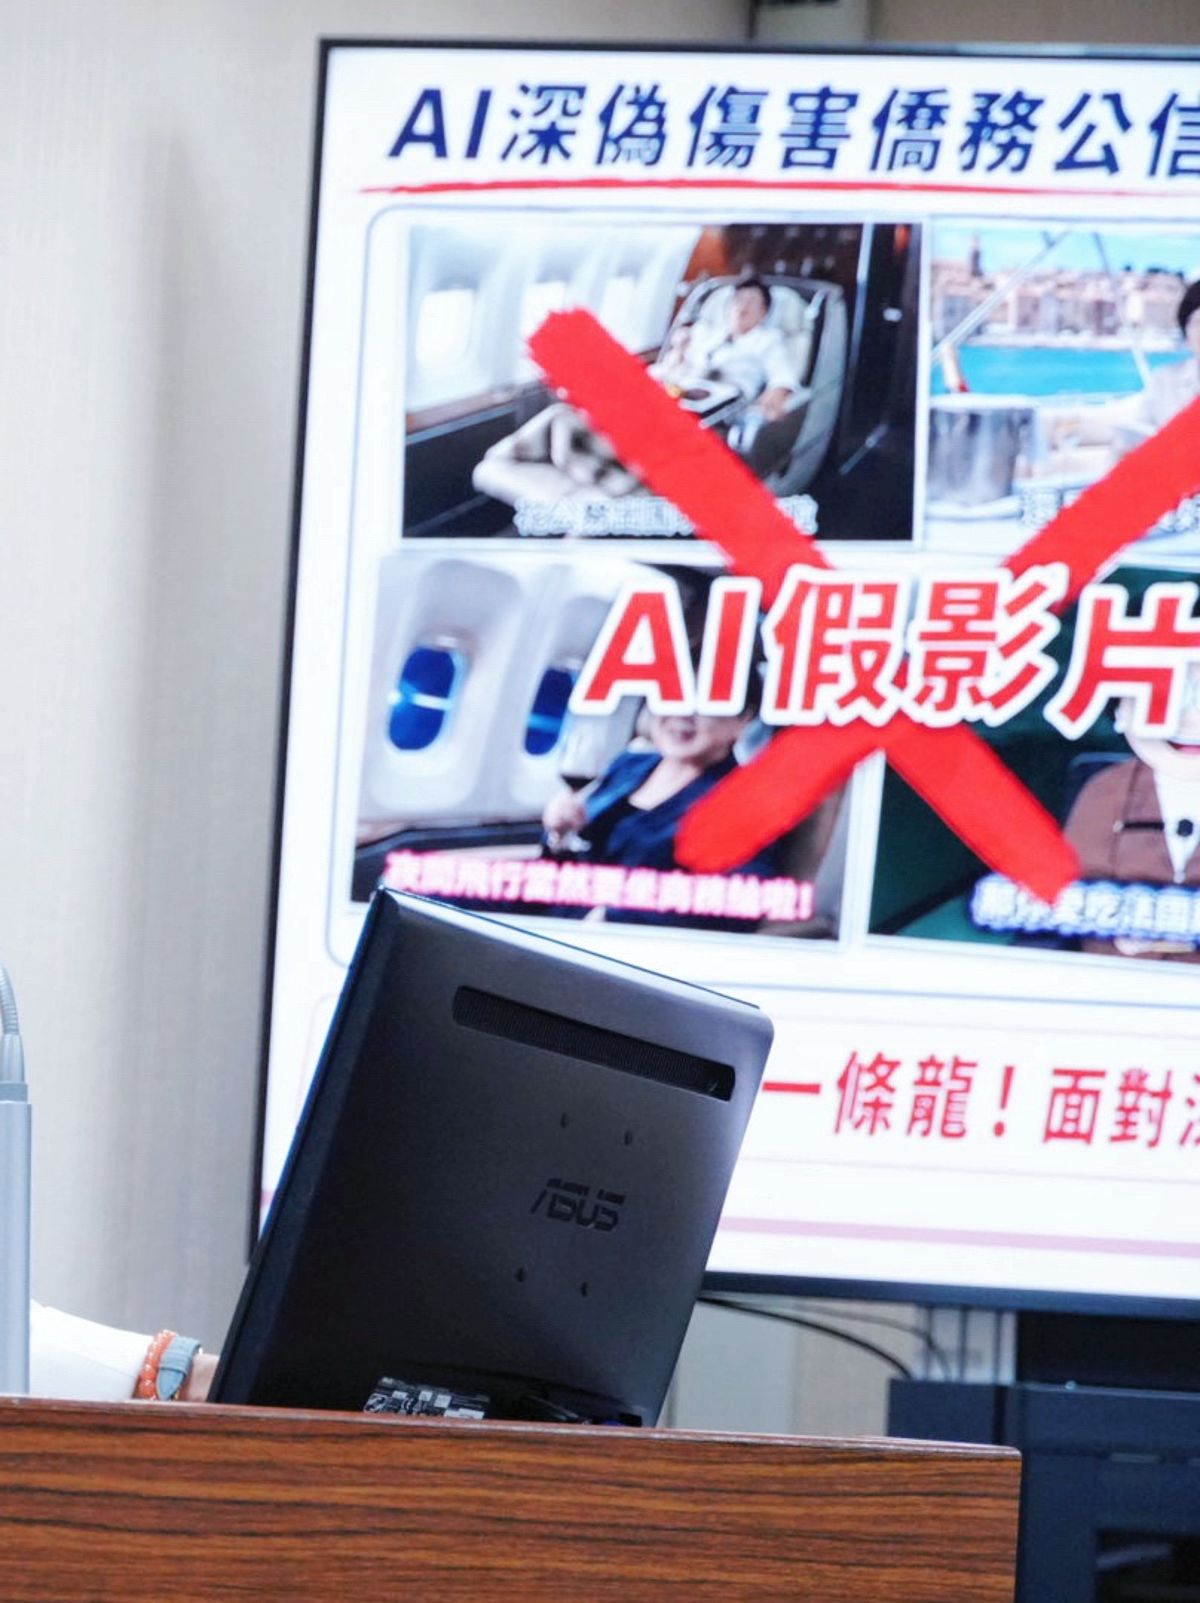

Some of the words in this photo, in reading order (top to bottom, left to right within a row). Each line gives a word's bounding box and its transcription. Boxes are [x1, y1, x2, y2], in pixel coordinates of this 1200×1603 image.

[389, 81, 1200, 177] AI深偽傷害僑務公信
[572, 567, 1200, 737] AI假影片
[530, 1178, 625, 1233] ASUS
